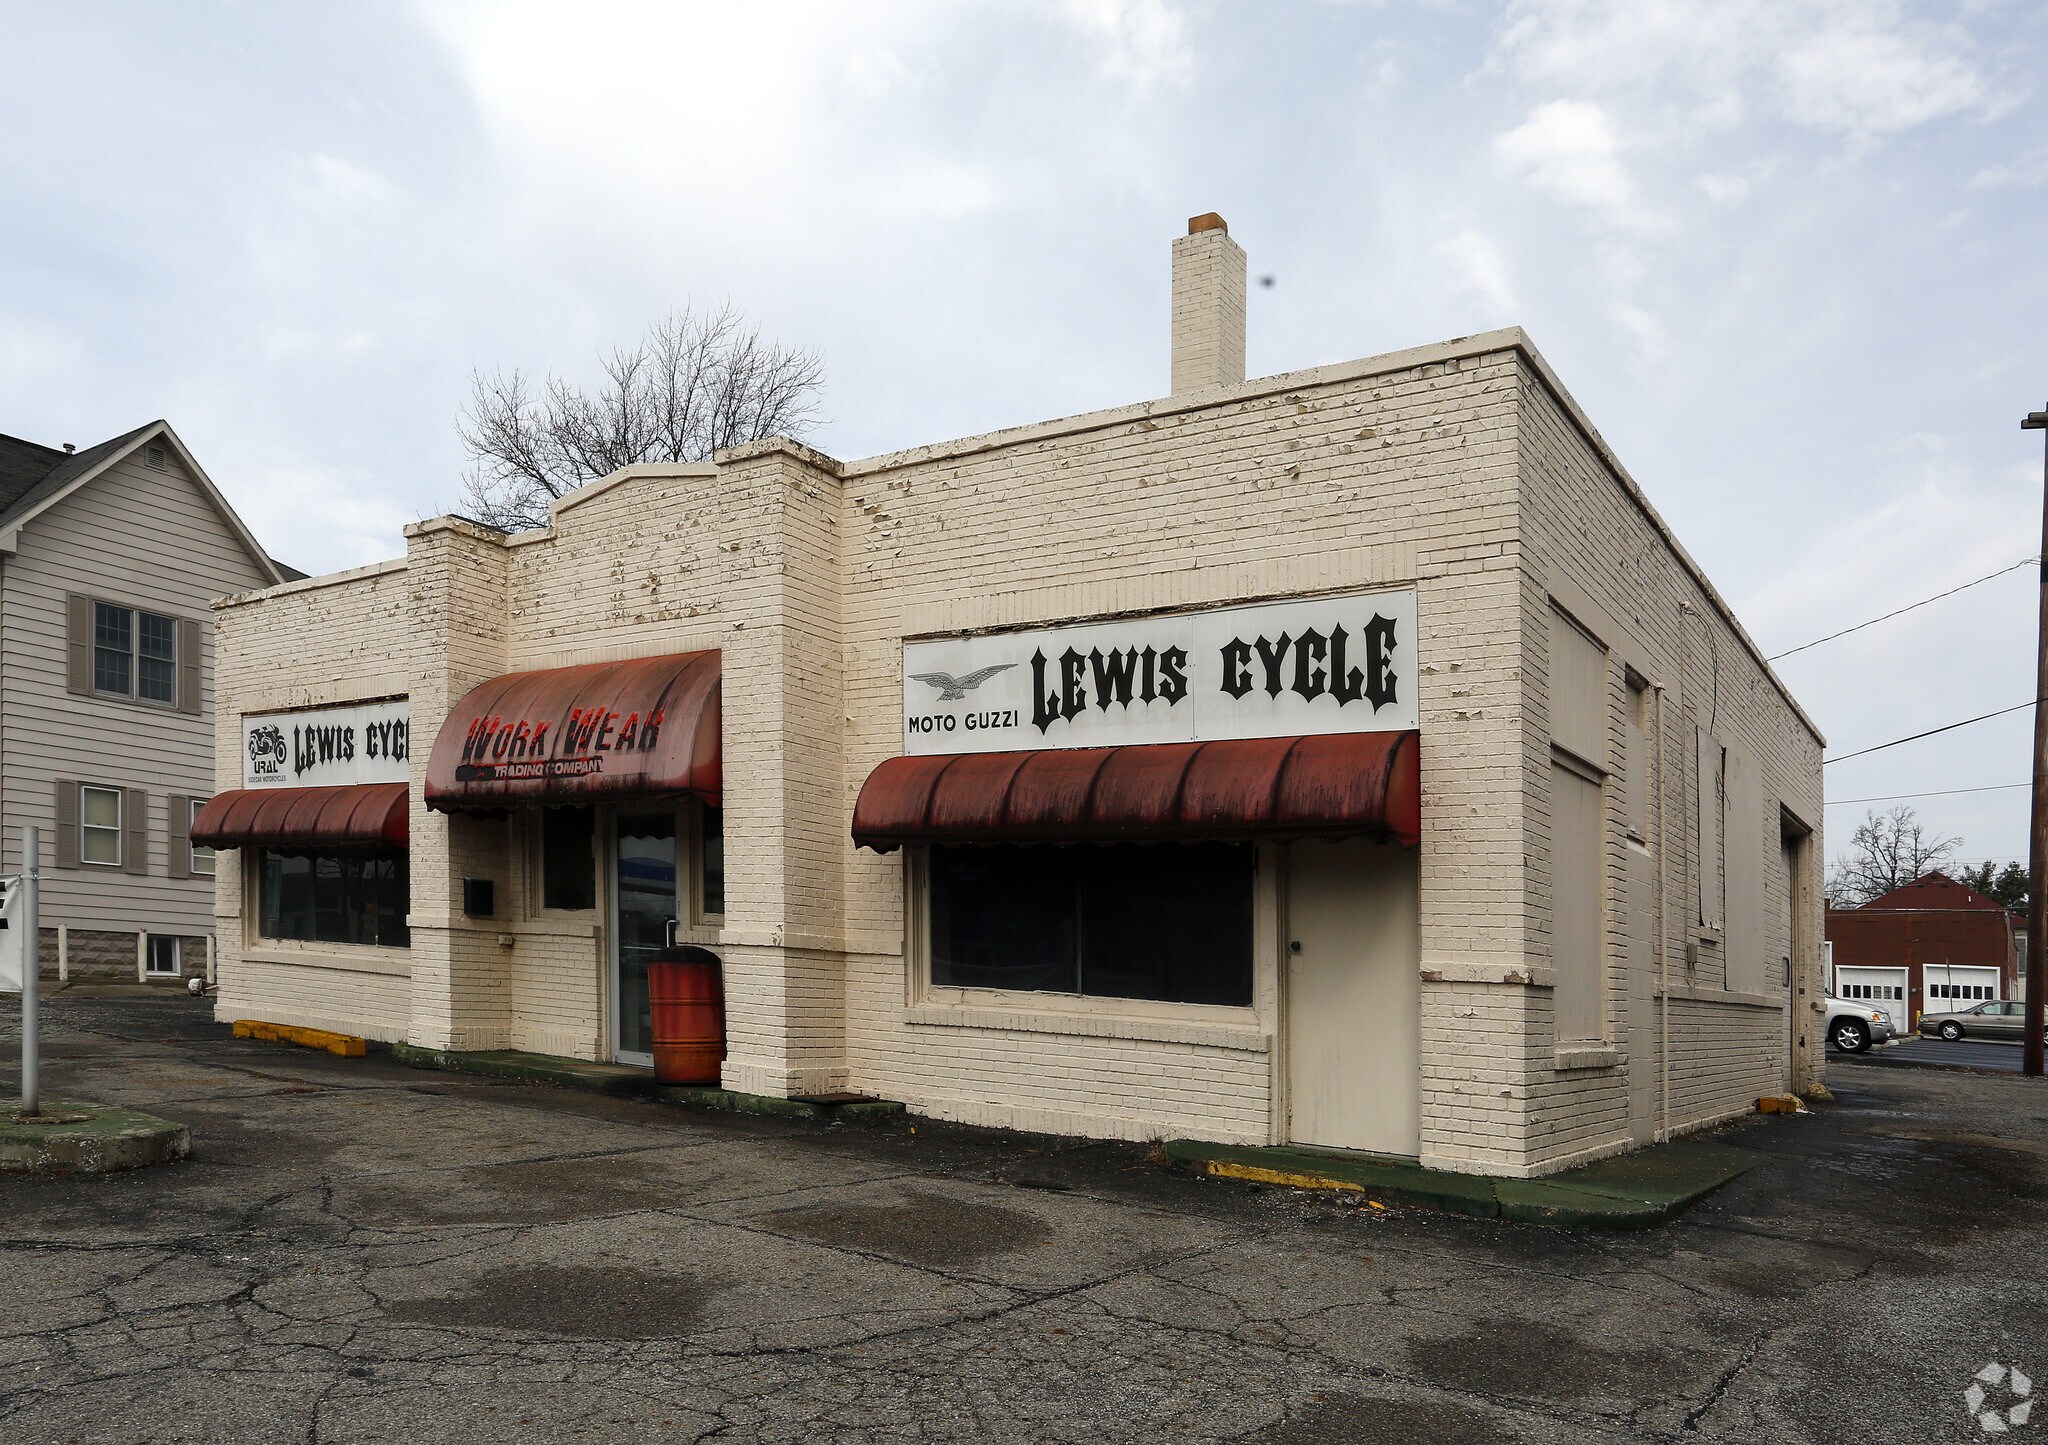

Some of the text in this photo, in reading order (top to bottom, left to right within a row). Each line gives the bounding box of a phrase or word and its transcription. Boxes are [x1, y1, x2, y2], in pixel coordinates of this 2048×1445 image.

[1030, 612, 1398, 735] LEWIS CYCLE
[461, 706, 665, 760] WORK WEAR
[908, 715, 956, 733] MOTO
[964, 710, 1019, 730] GUZZI
[254, 760, 279, 774] URAL
[293, 723, 355, 779] LEWIS
[493, 759, 603, 778] TRADING COMPANY
